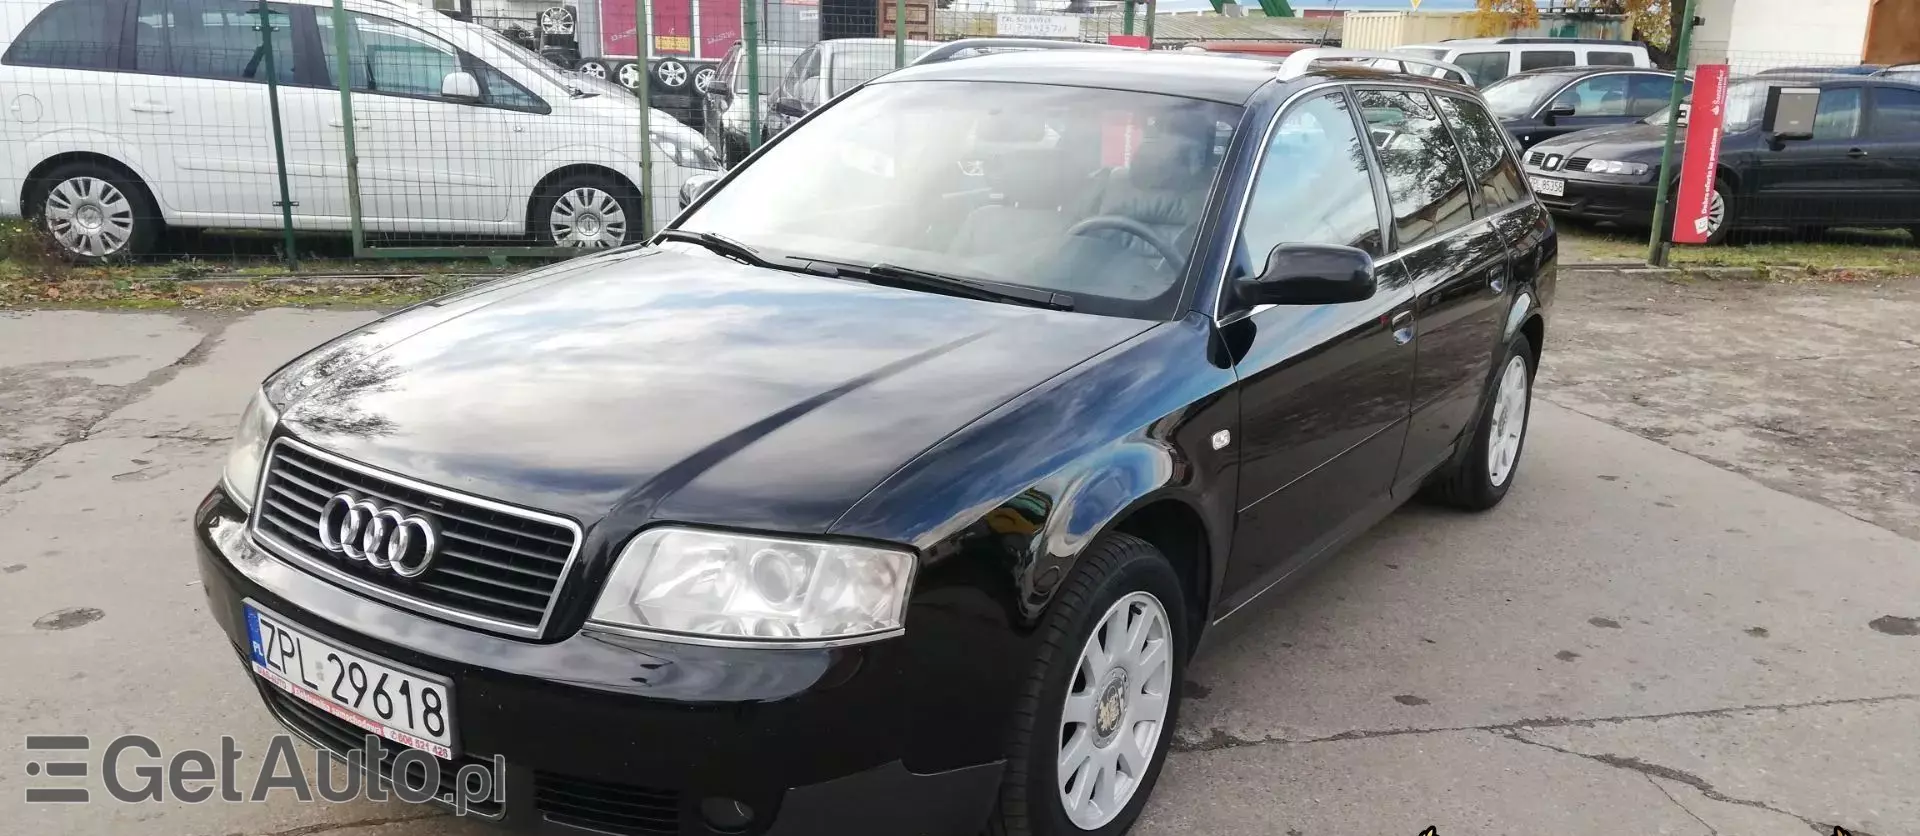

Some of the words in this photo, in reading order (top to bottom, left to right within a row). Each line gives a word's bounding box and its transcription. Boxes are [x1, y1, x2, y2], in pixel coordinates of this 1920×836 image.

[1713, 69, 1724, 105] Santander
[253, 641, 264, 657] PL
[261, 618, 319, 691] ZPL
[327, 653, 445, 738] 29618
